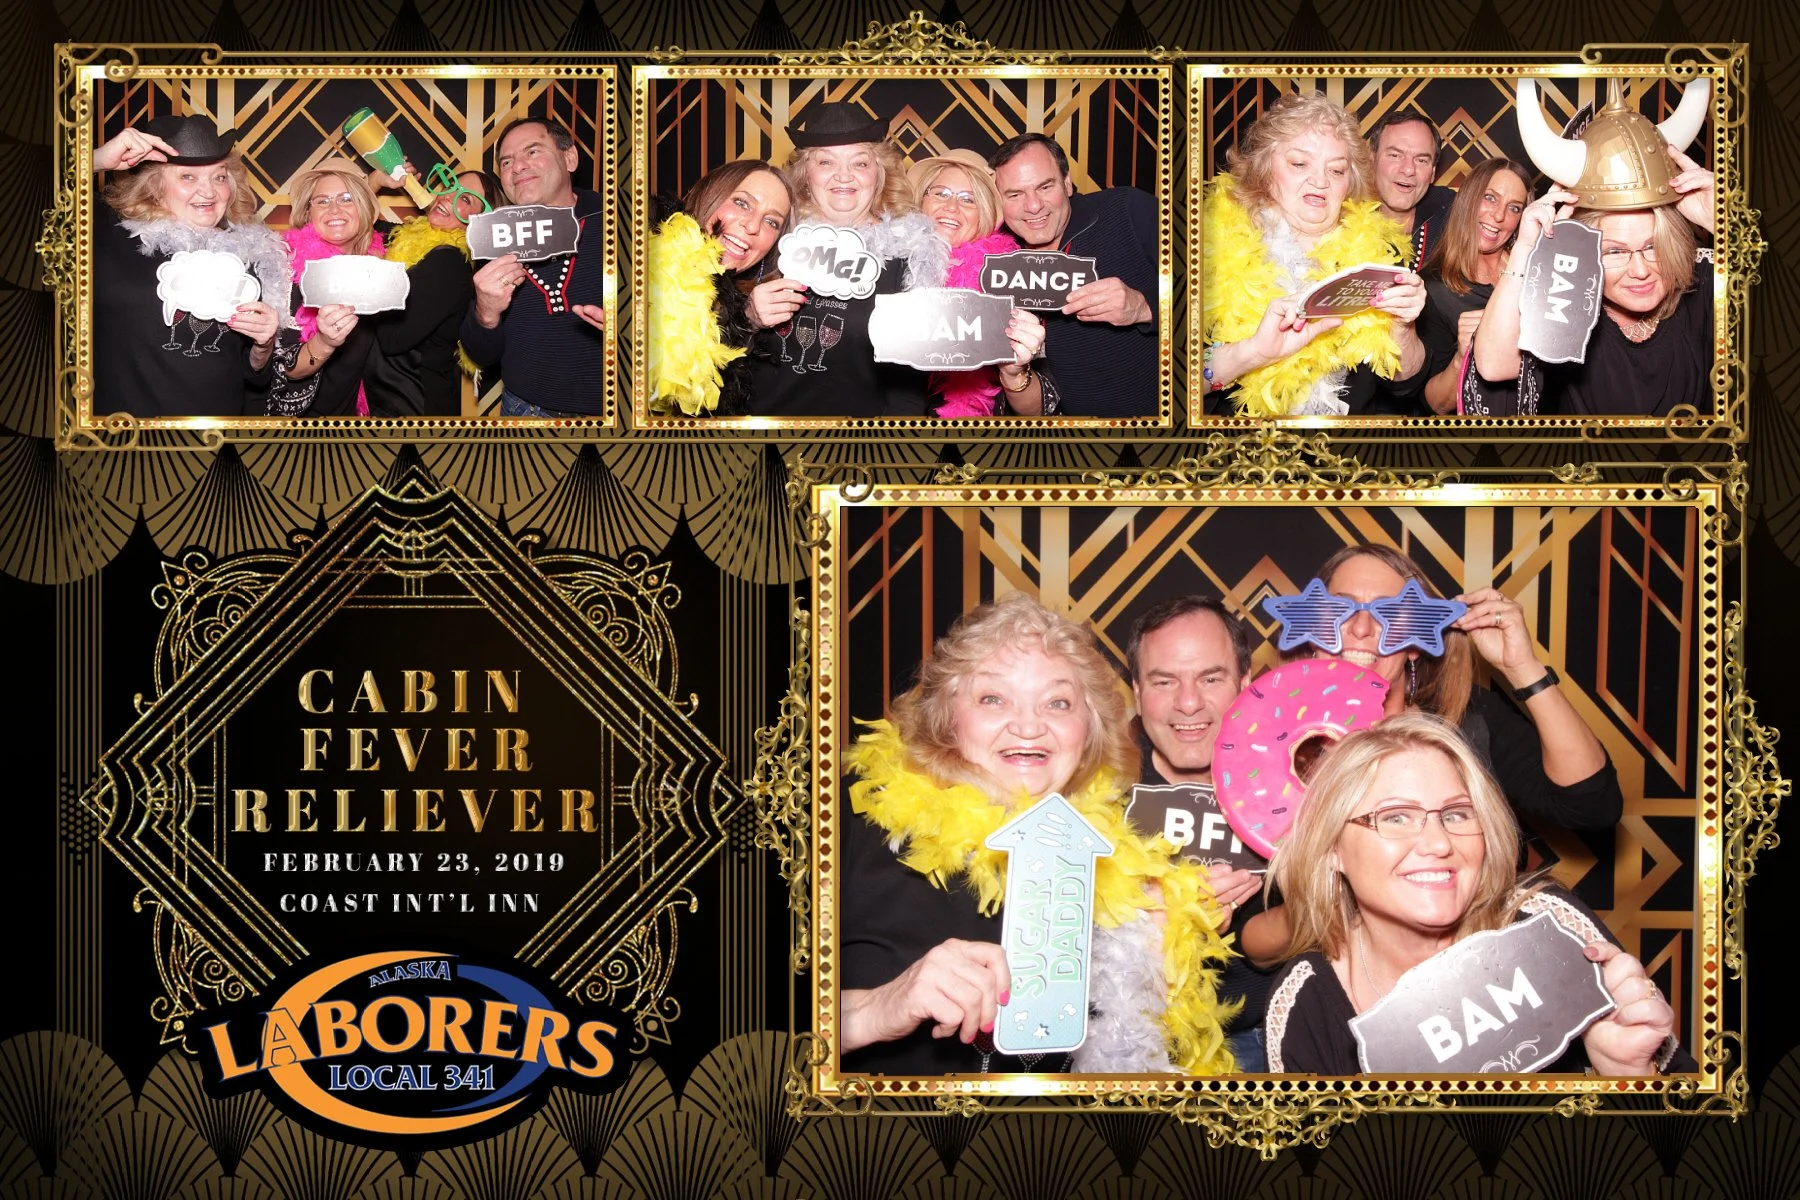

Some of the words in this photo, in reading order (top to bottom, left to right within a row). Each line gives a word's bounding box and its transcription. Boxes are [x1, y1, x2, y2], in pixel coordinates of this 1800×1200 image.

[491, 219, 553, 248] BFF
[791, 245, 868, 283] OMG!
[990, 269, 1086, 291] DANCE
[1336, 287, 1354, 295] TO
[1347, 279, 1376, 288] TAKE
[1543, 252, 1579, 324] BAM
[911, 315, 983, 342] AM
[1050, 855, 1087, 982] DADDY
[1010, 879, 1052, 999] SUGAR
[1416, 966, 1544, 1064] BAM
